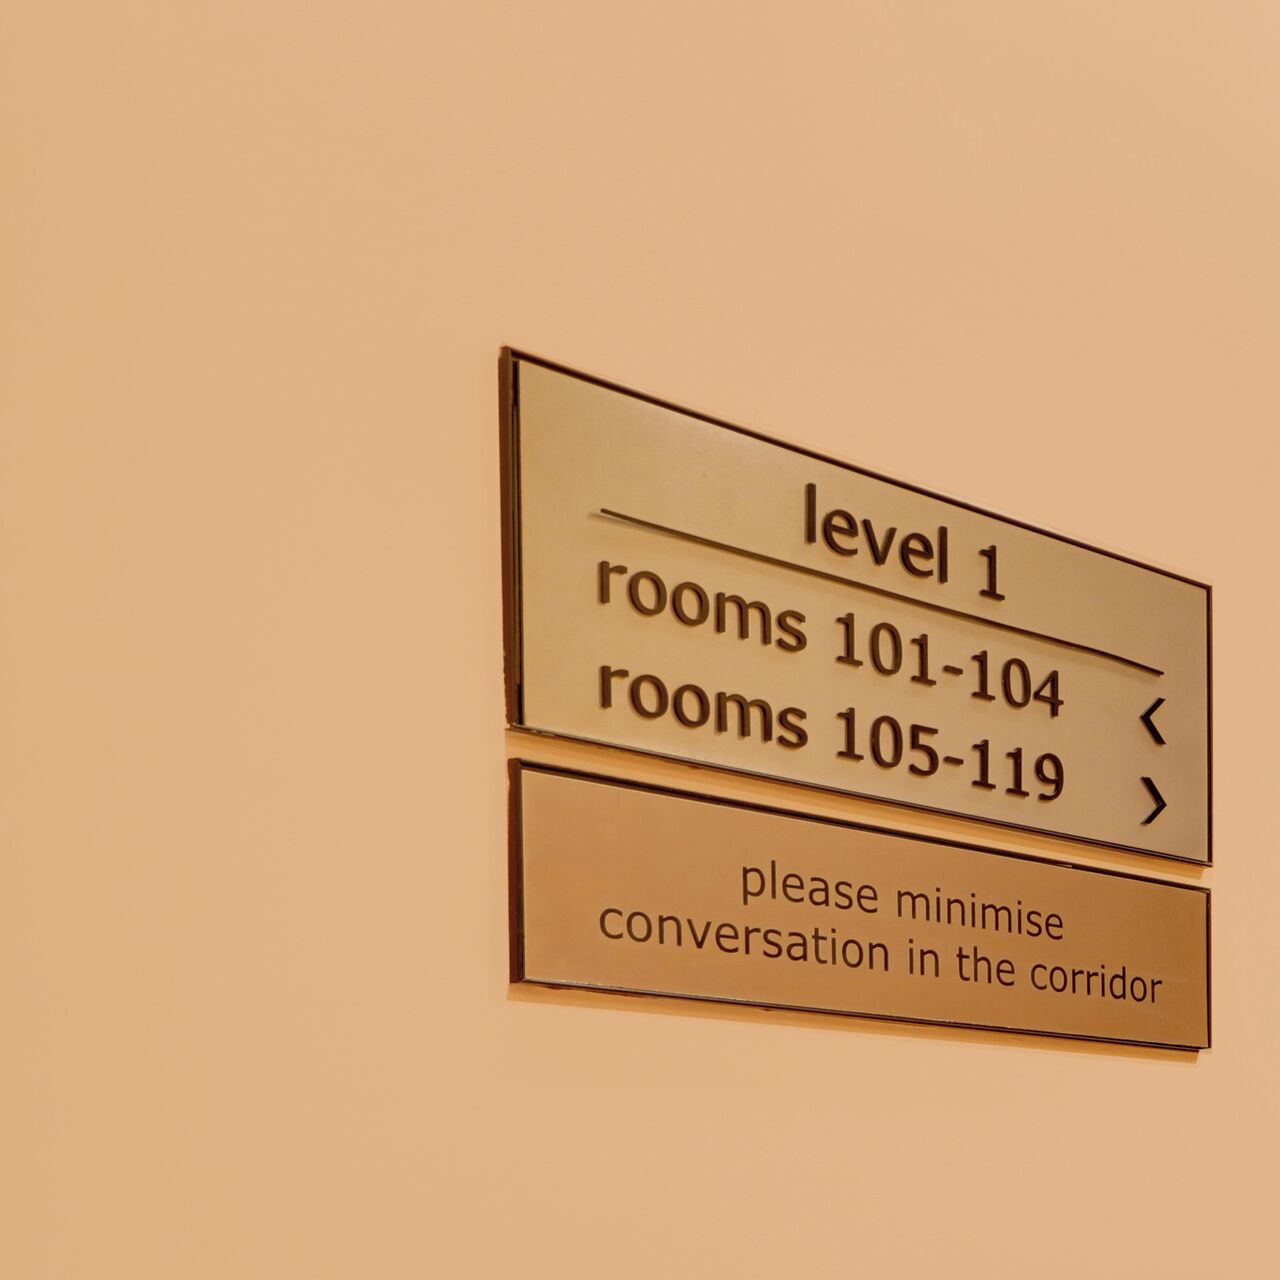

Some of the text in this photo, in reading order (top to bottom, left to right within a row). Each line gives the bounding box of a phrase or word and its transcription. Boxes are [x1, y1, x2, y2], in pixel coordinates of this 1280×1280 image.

[805, 482, 1006, 602] level 1
[597, 559, 1065, 718] rooms 101-104
[598, 663, 1066, 802] rooms 105-119
[599, 908, 1163, 1003] conversation in the corridor
[741, 859, 1065, 941] please minimise
